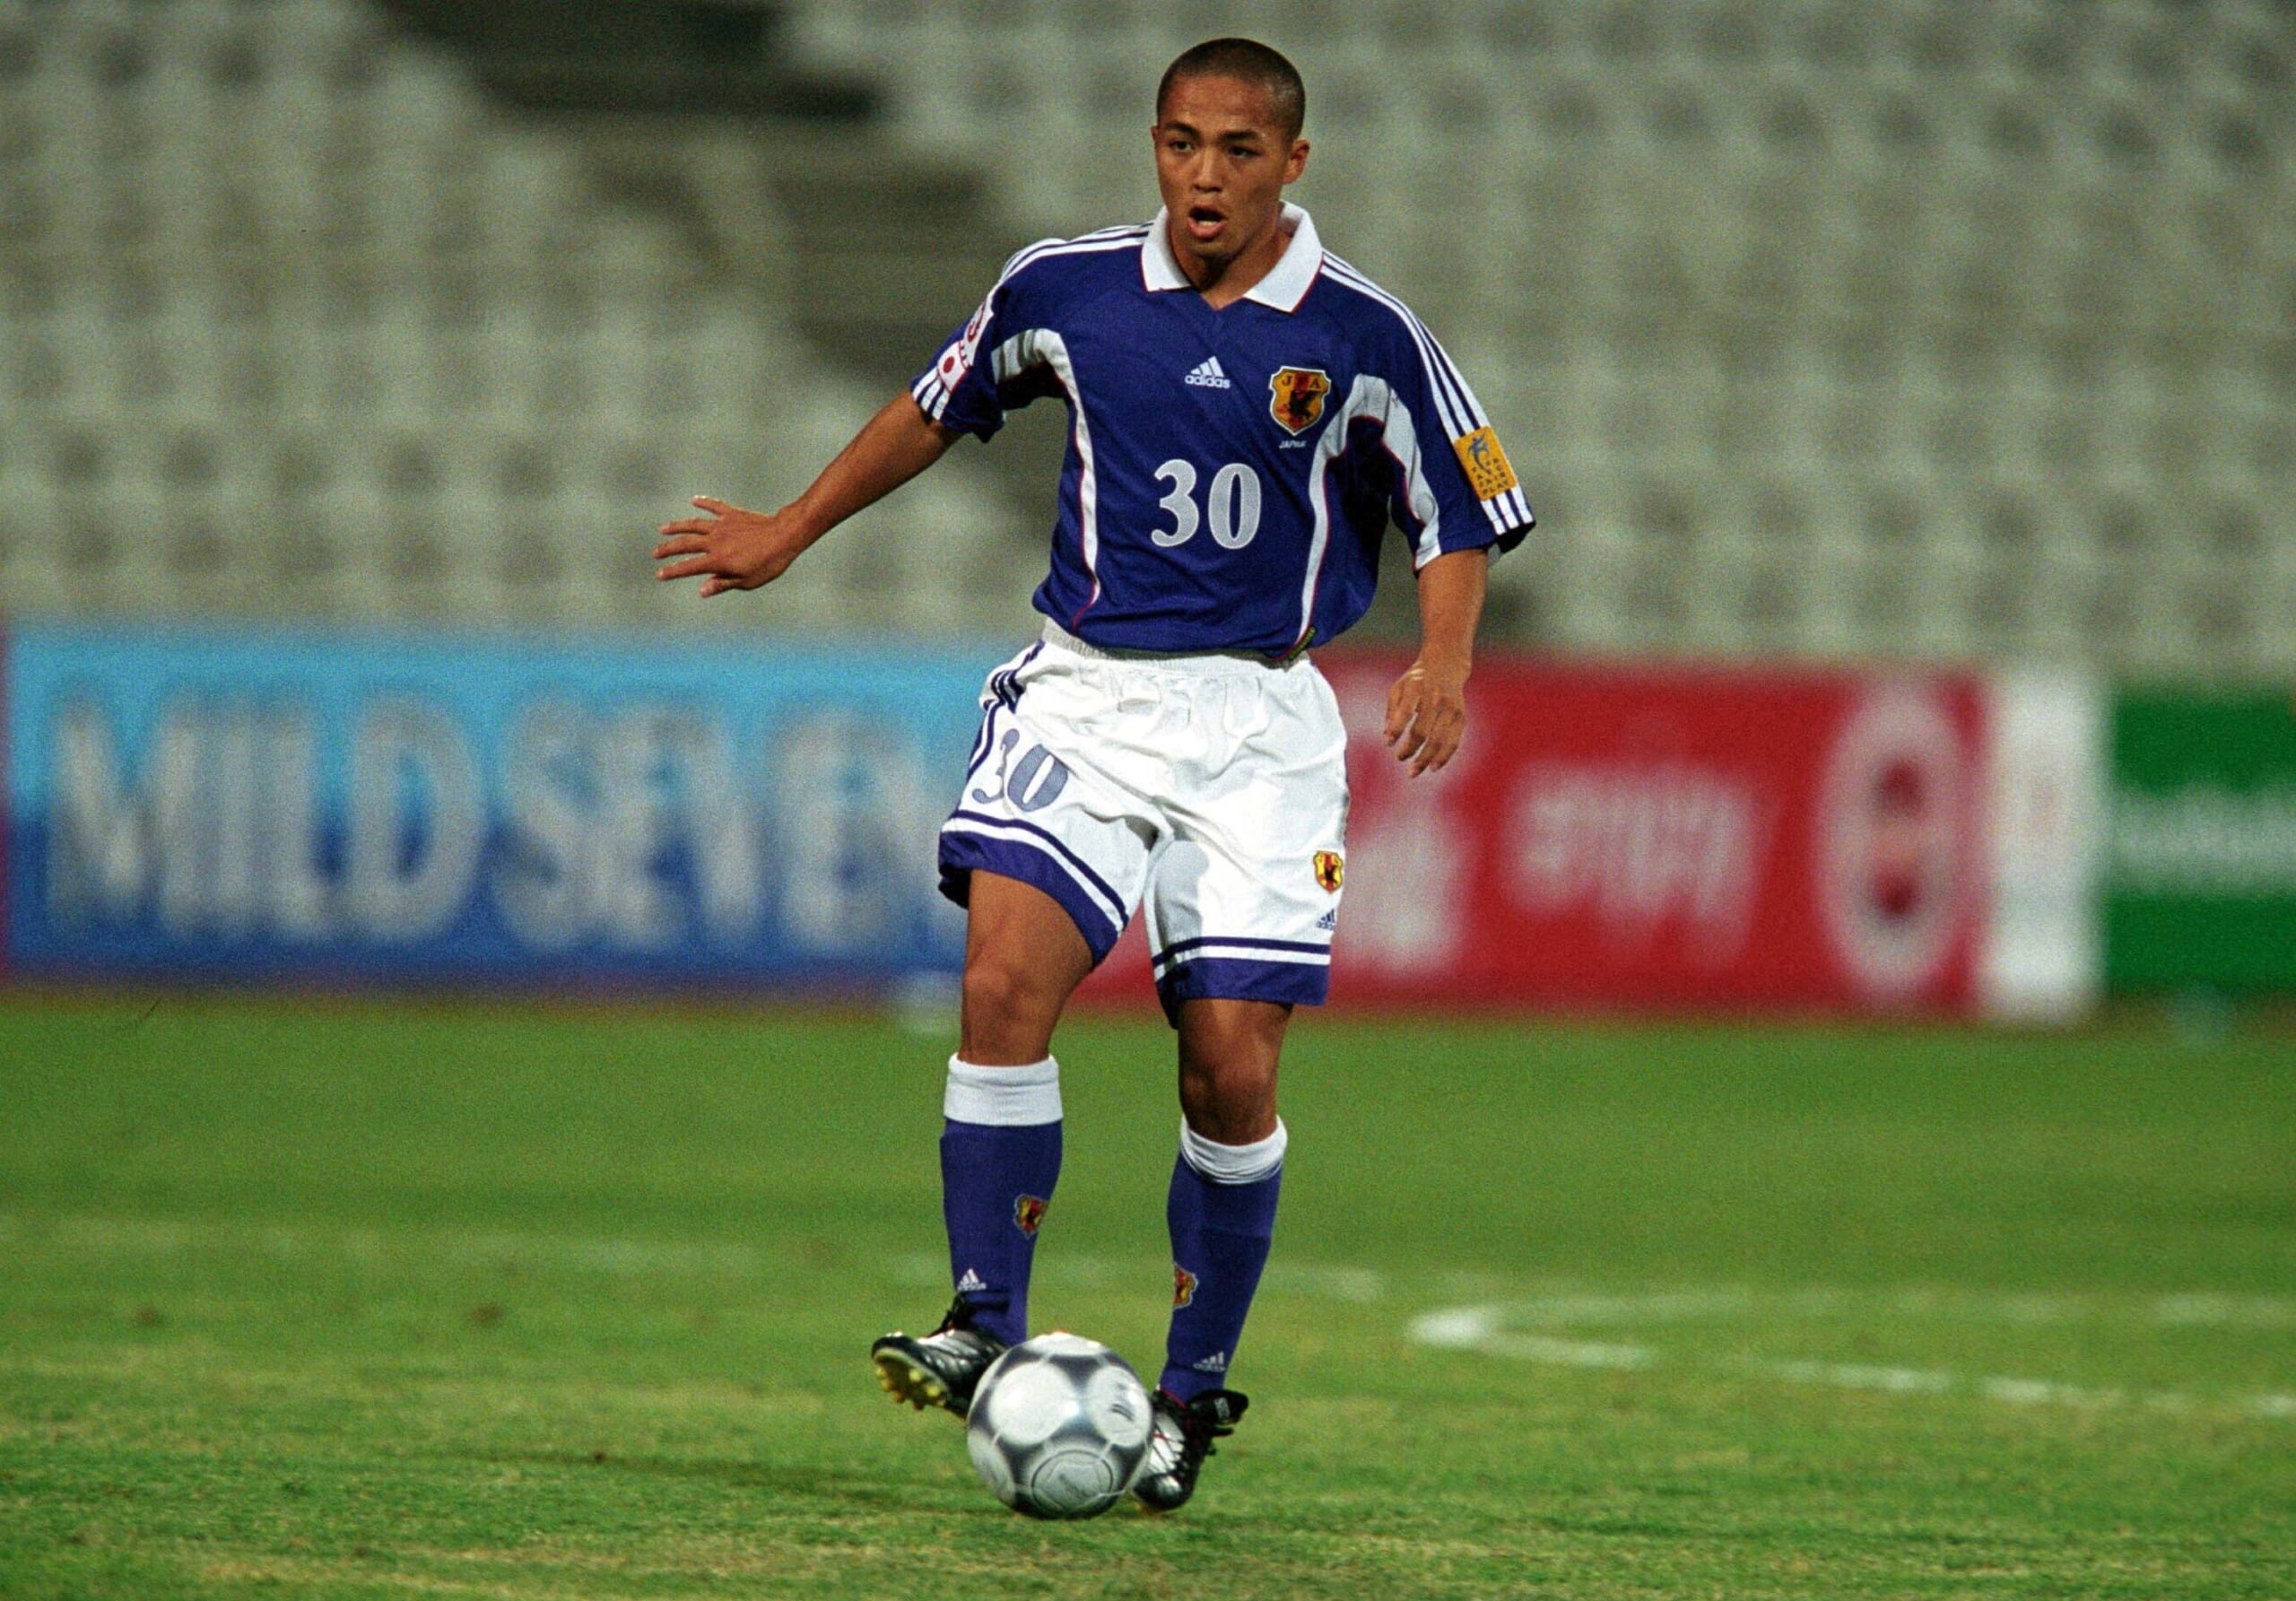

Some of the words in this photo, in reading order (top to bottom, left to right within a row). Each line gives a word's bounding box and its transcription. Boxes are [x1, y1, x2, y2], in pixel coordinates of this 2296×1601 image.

[1185, 374, 1231, 389] adidas
[1151, 458, 1262, 550] 30
[971, 727, 1068, 813] 30
[47, 687, 484, 945] MILD
[496, 691, 961, 953] SEVEN
